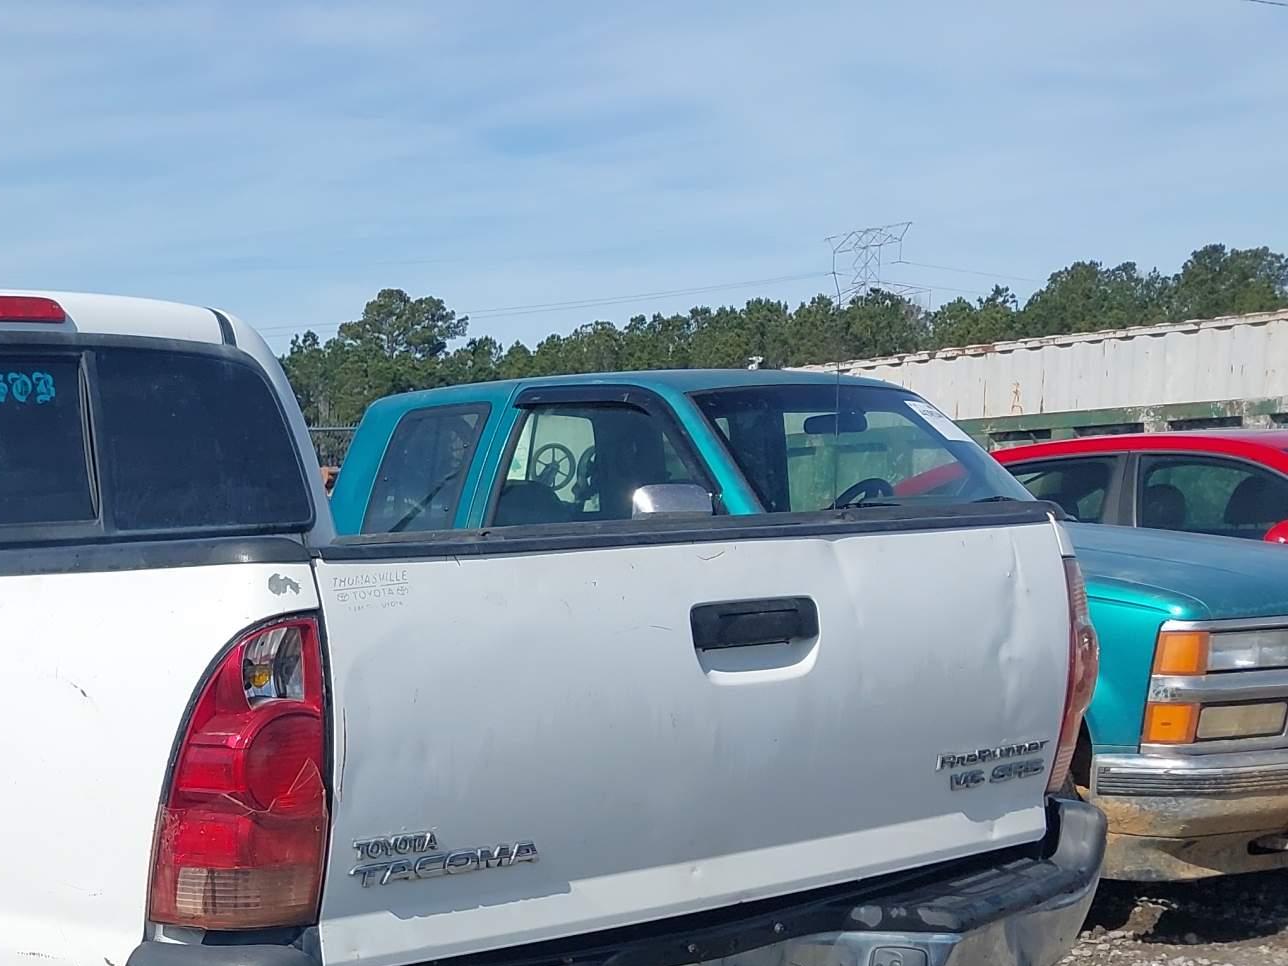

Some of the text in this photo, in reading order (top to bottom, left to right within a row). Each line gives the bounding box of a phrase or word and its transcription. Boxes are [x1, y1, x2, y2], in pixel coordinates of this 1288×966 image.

[352, 587, 395, 601] TOYOTA
[950, 769, 985, 791] V6
[353, 831, 439, 861] TOYOTA
[348, 841, 540, 888] TACOMA
